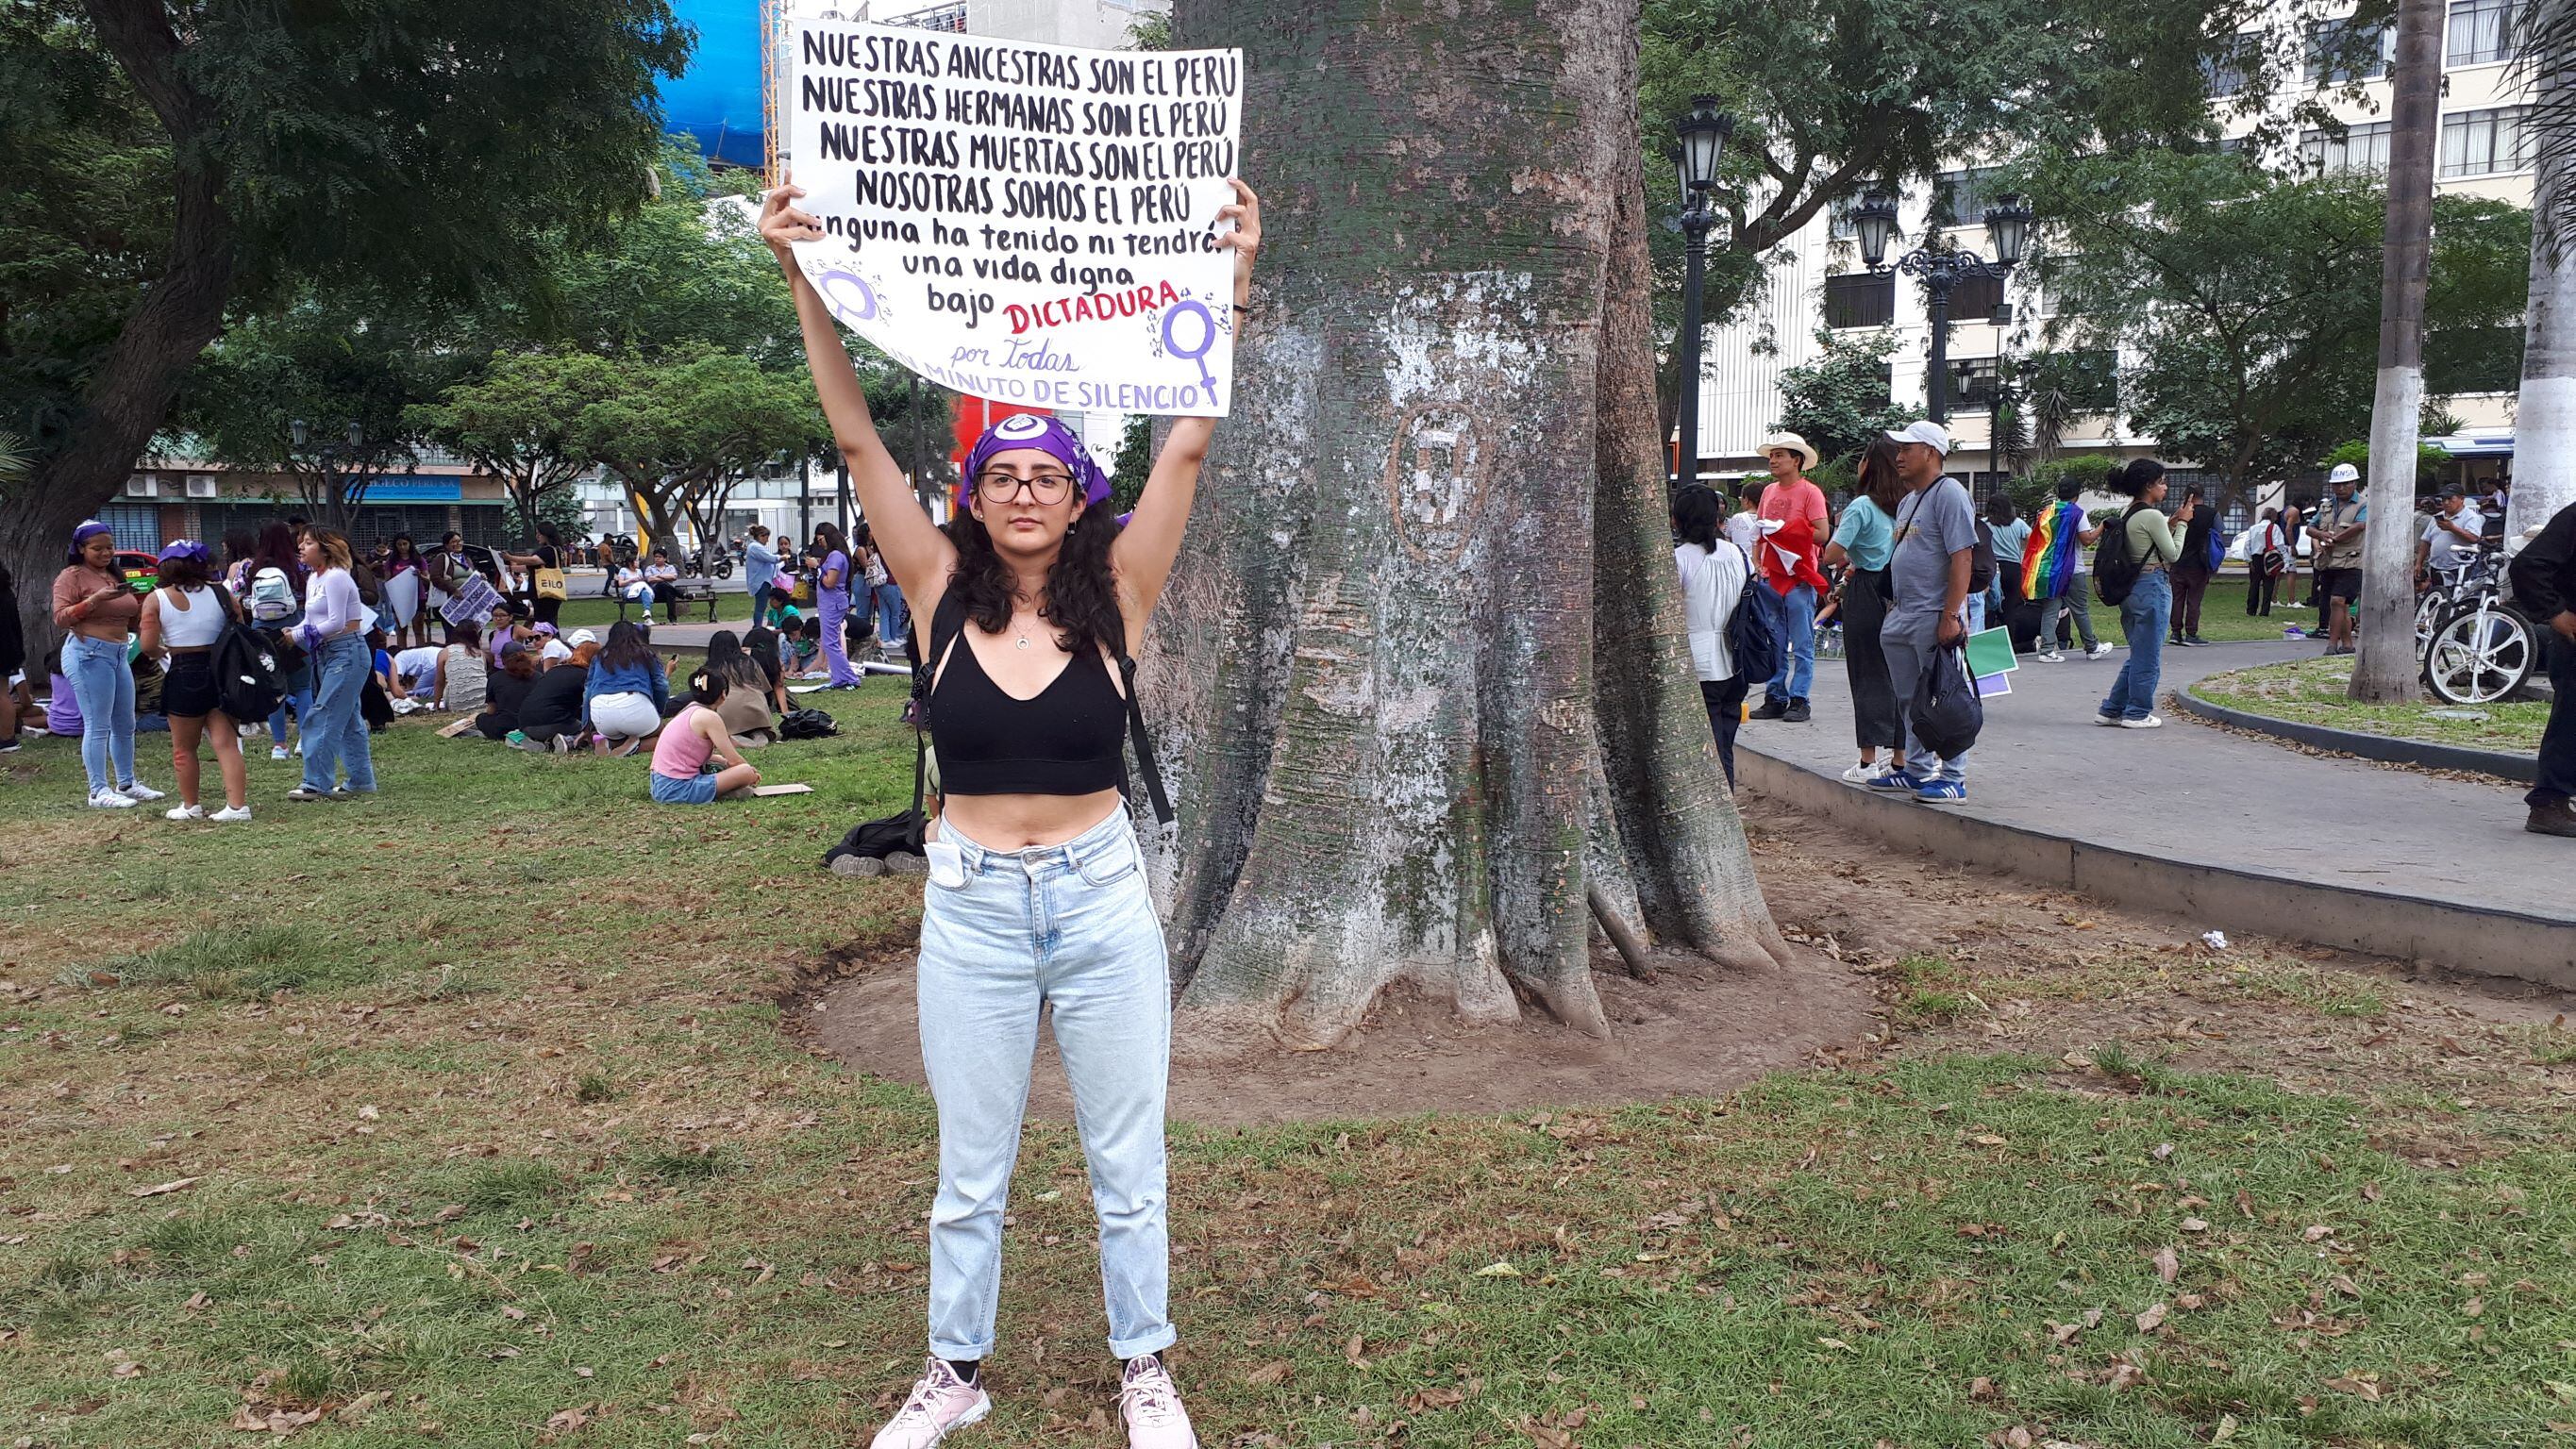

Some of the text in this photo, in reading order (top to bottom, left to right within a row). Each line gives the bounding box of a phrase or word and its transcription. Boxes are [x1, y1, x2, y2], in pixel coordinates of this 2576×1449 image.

[803, 29, 1236, 97] NUESTRAS ANCESTRAS SON EL PERÚ
[802, 74, 1227, 138] NUESTRAS HERMANAS SON EL PERÚ
[820, 121, 1233, 182] NUESTRAS MUERTAS SON EL PERÚ
[856, 169, 1191, 225] NOSOTRAS SOMOS EL PERÚ
[797, 214, 1222, 257] nguna ha tenido ni tendrá
[902, 254, 1135, 296] una vida digna
[928, 279, 1179, 334] bajo DICTADURA
[950, 345, 990, 368] por
[924, 362, 1026, 397] MINUTO
[1033, 379, 1070, 404] DE
[1078, 381, 1198, 409] SILENCIO
